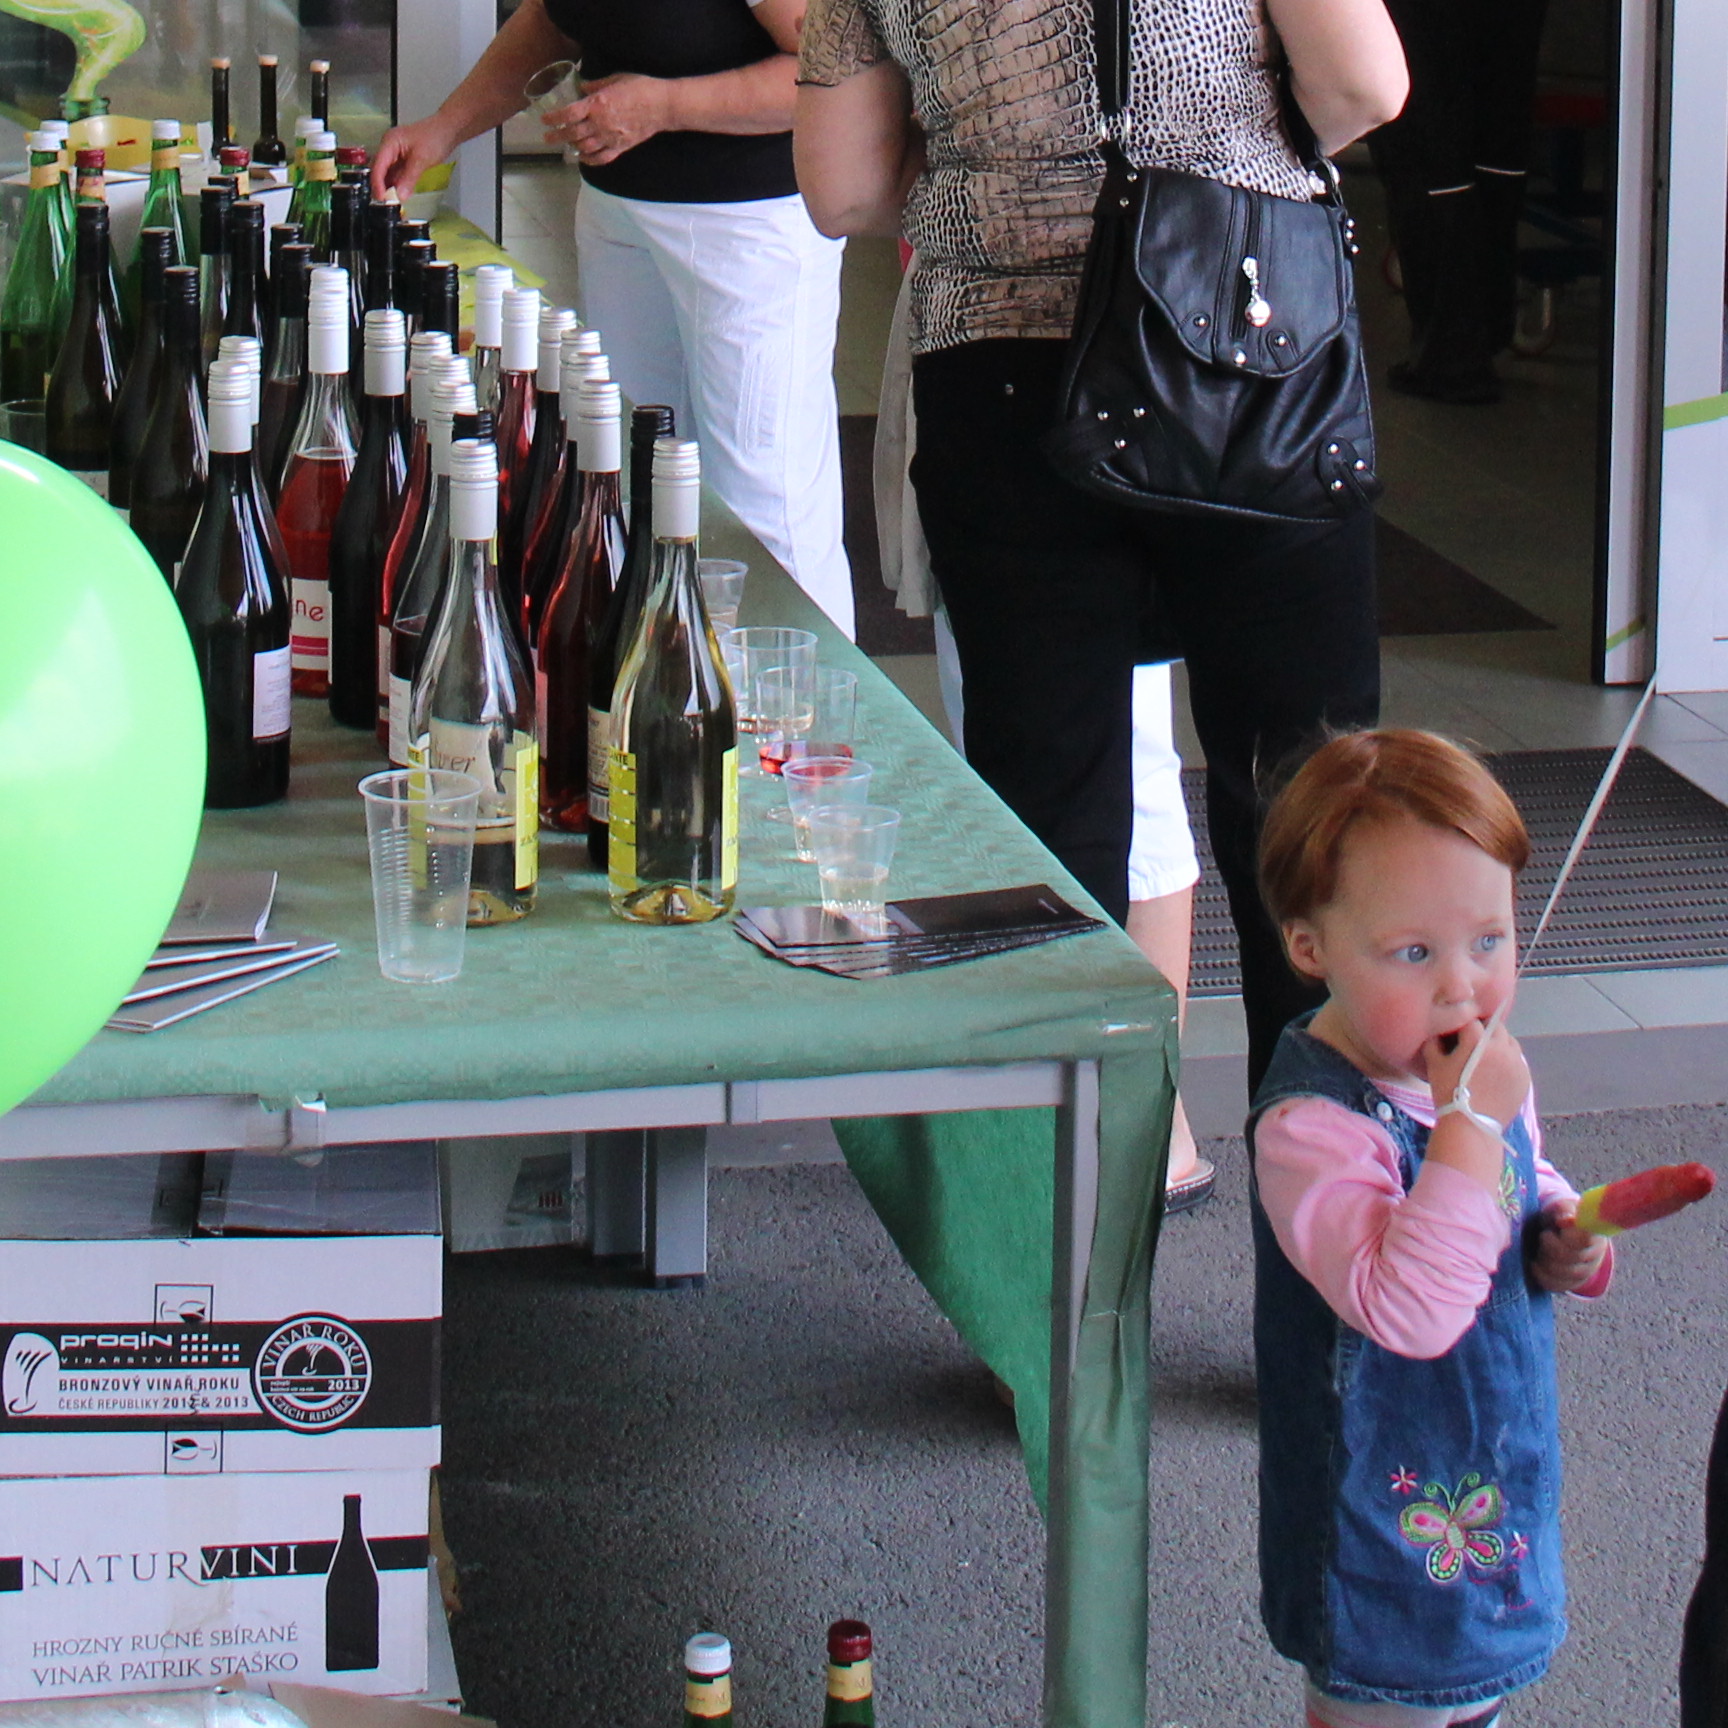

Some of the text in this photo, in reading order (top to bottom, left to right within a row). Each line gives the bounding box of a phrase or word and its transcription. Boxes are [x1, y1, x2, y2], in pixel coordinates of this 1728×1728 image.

[262, 1322, 365, 1368] VINAŘ ROKU
[59, 1374, 240, 1392] BRONZOVÝ VINAŘ ROKU
[328, 1379, 360, 1391] 2013
[58, 1396, 94, 1410] ČESKÉ
[98, 1397, 160, 1410] REPUBLIKY
[201, 1397, 210, 1408] &
[216, 1396, 249, 1408] 2013
[272, 1394, 354, 1422] CZECH REPUBLIC
[31, 1544, 298, 1588] NATURVINI
[33, 1636, 124, 1658] HROZNY
[210, 1620, 298, 1647] SBÍRANÉ
[33, 1650, 298, 1688] VINAŘ PATRIK STAŠKO
